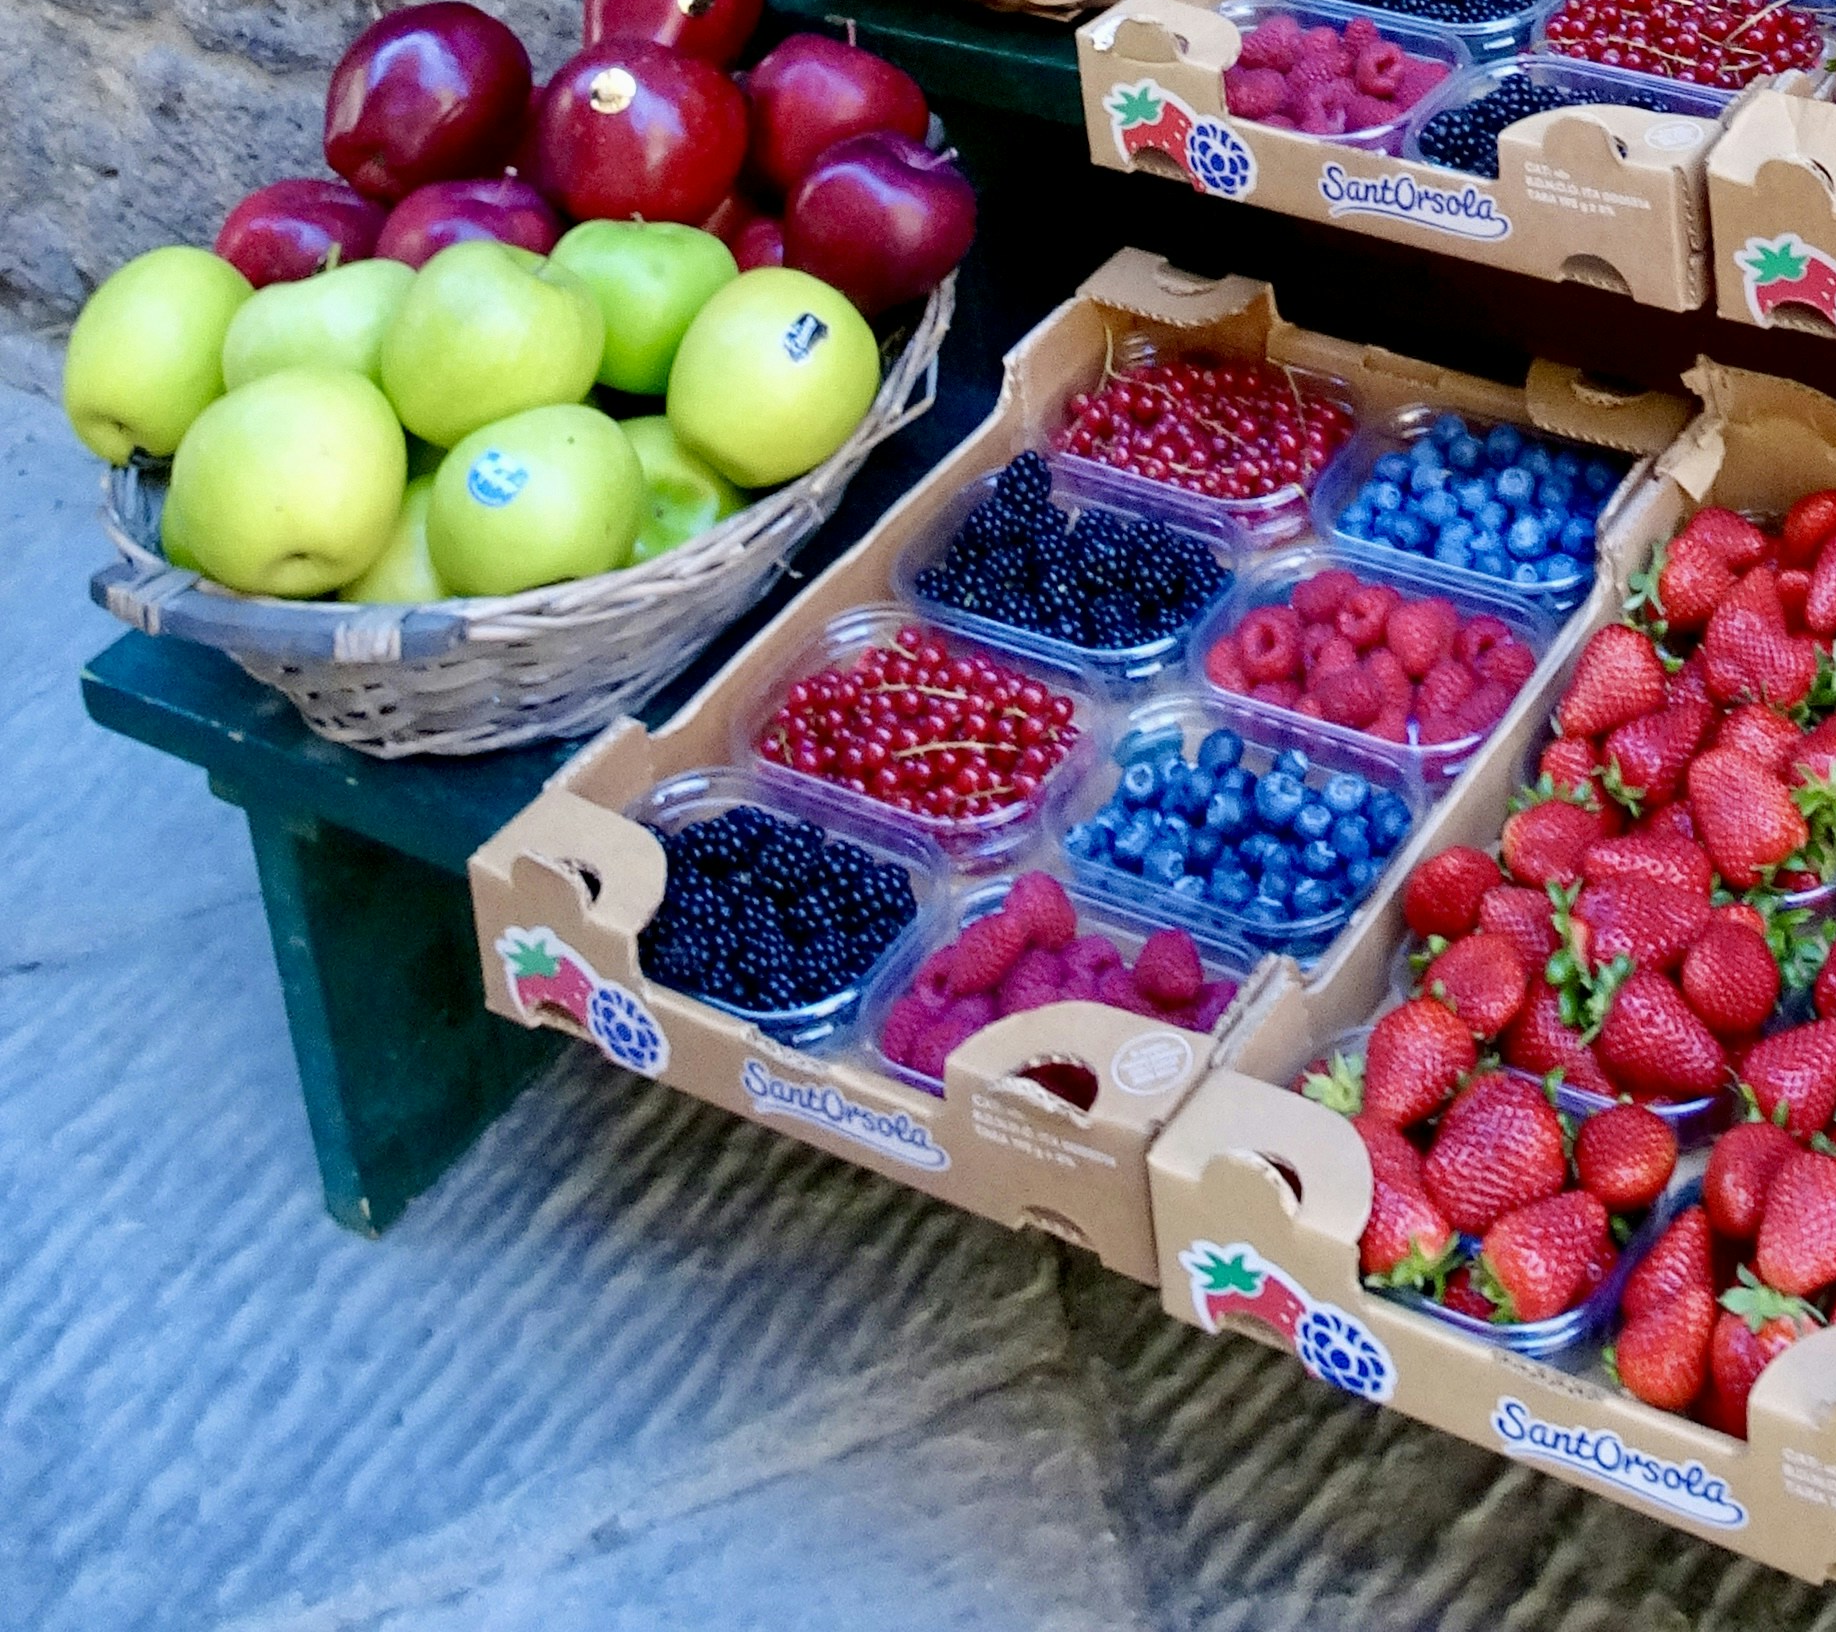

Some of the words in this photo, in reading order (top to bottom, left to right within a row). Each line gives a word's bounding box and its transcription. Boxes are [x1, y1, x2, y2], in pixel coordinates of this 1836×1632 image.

[1322, 165, 1496, 222] SantOrsola
[743, 1060, 933, 1152] SantOrsola
[1495, 1403, 1731, 1508] SantOrsola
